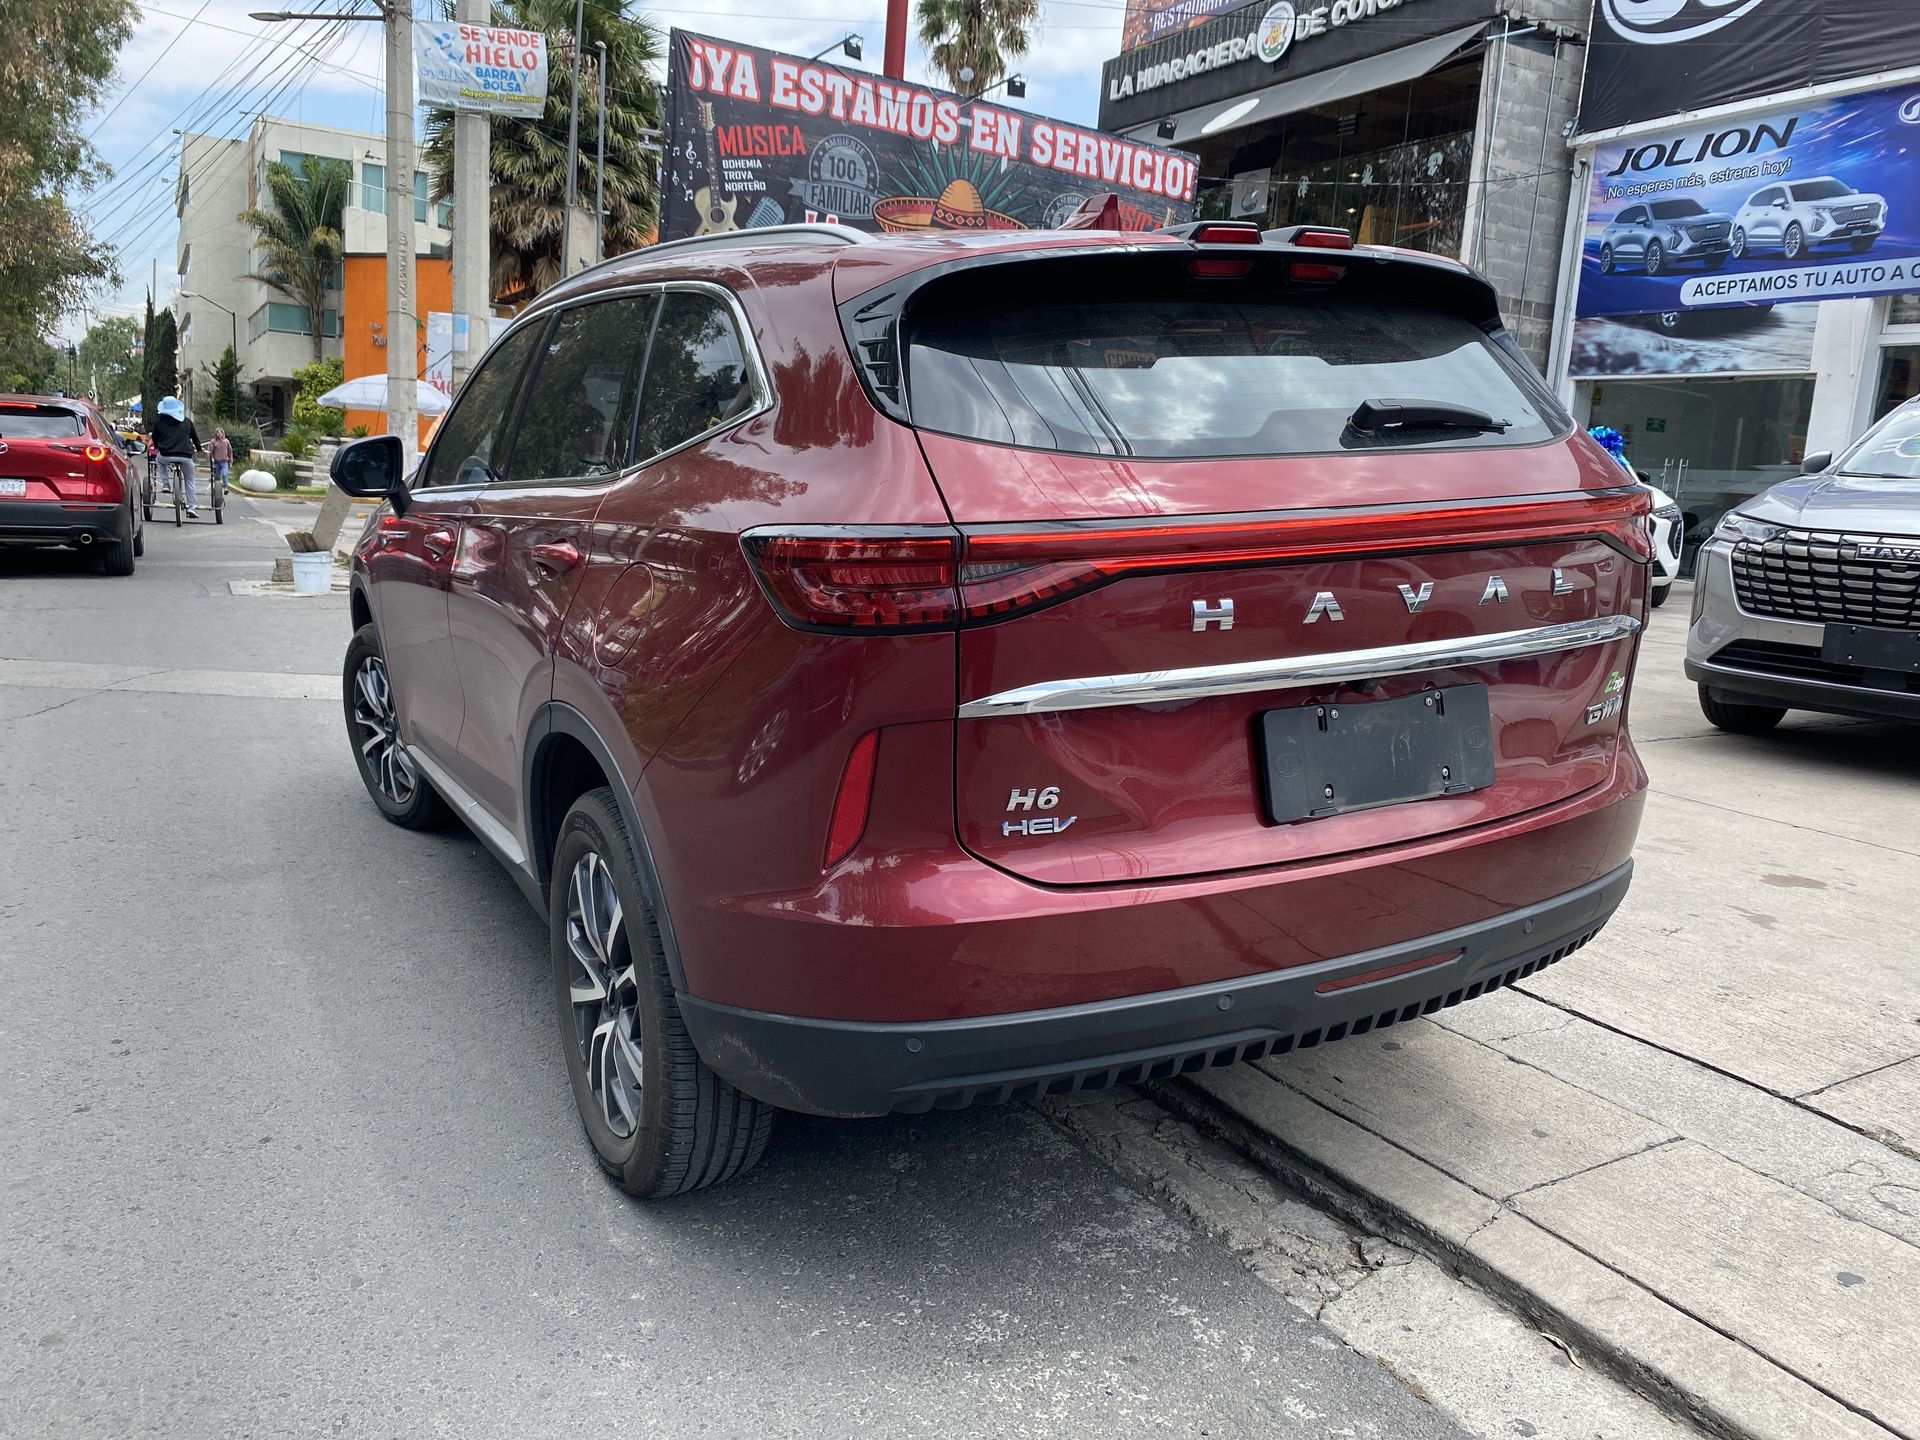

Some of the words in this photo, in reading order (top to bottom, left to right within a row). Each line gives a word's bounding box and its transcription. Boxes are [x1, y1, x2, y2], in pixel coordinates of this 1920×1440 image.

[460, 26, 480, 41] SE
[486, 29, 539, 48] VENDE
[466, 43, 538, 71] HIELO
[1110, 75, 1134, 100] LA
[1136, 33, 1258, 93] HUARACHERA
[1295, 6, 1328, 41] DE
[476, 67, 518, 82] BARRA
[521, 72, 529, 83] Y
[484, 80, 522, 93] BOLSA
[460, 88, 497, 101] Mayoreo
[507, 94, 543, 104] Menudeo
[690, 43, 759, 100] ¡YA
[771, 61, 960, 144] ESTAMOS
[972, 107, 1022, 158] EN
[1031, 123, 1196, 199] SERVICIO!
[717, 124, 807, 157] MUSICA
[824, 137, 866, 156] AMBIENTE
[1606, 117, 1799, 177] JOLION
[722, 159, 763, 170] BOHEMIA
[724, 171, 754, 181] TROVA
[725, 181, 767, 192] NORTEÑO
[1603, 185, 1624, 203] ¡No
[1627, 178, 1673, 197] esperes
[1676, 173, 1706, 188] más,
[1709, 168, 1758, 184] estrena
[1762, 157, 1792, 181] hoy!
[811, 183, 871, 215] FAMILIAR
[1692, 274, 1798, 298] ACEPTAMOS
[1804, 272, 1828, 288] TU
[1831, 266, 1886, 286] AUTO
[1890, 264, 1904, 281] A
[431, 370, 443, 380] LA
[1584, 695, 1622, 725] GWM
[1006, 786, 1061, 812] H6
[1002, 816, 1077, 836] HEV
